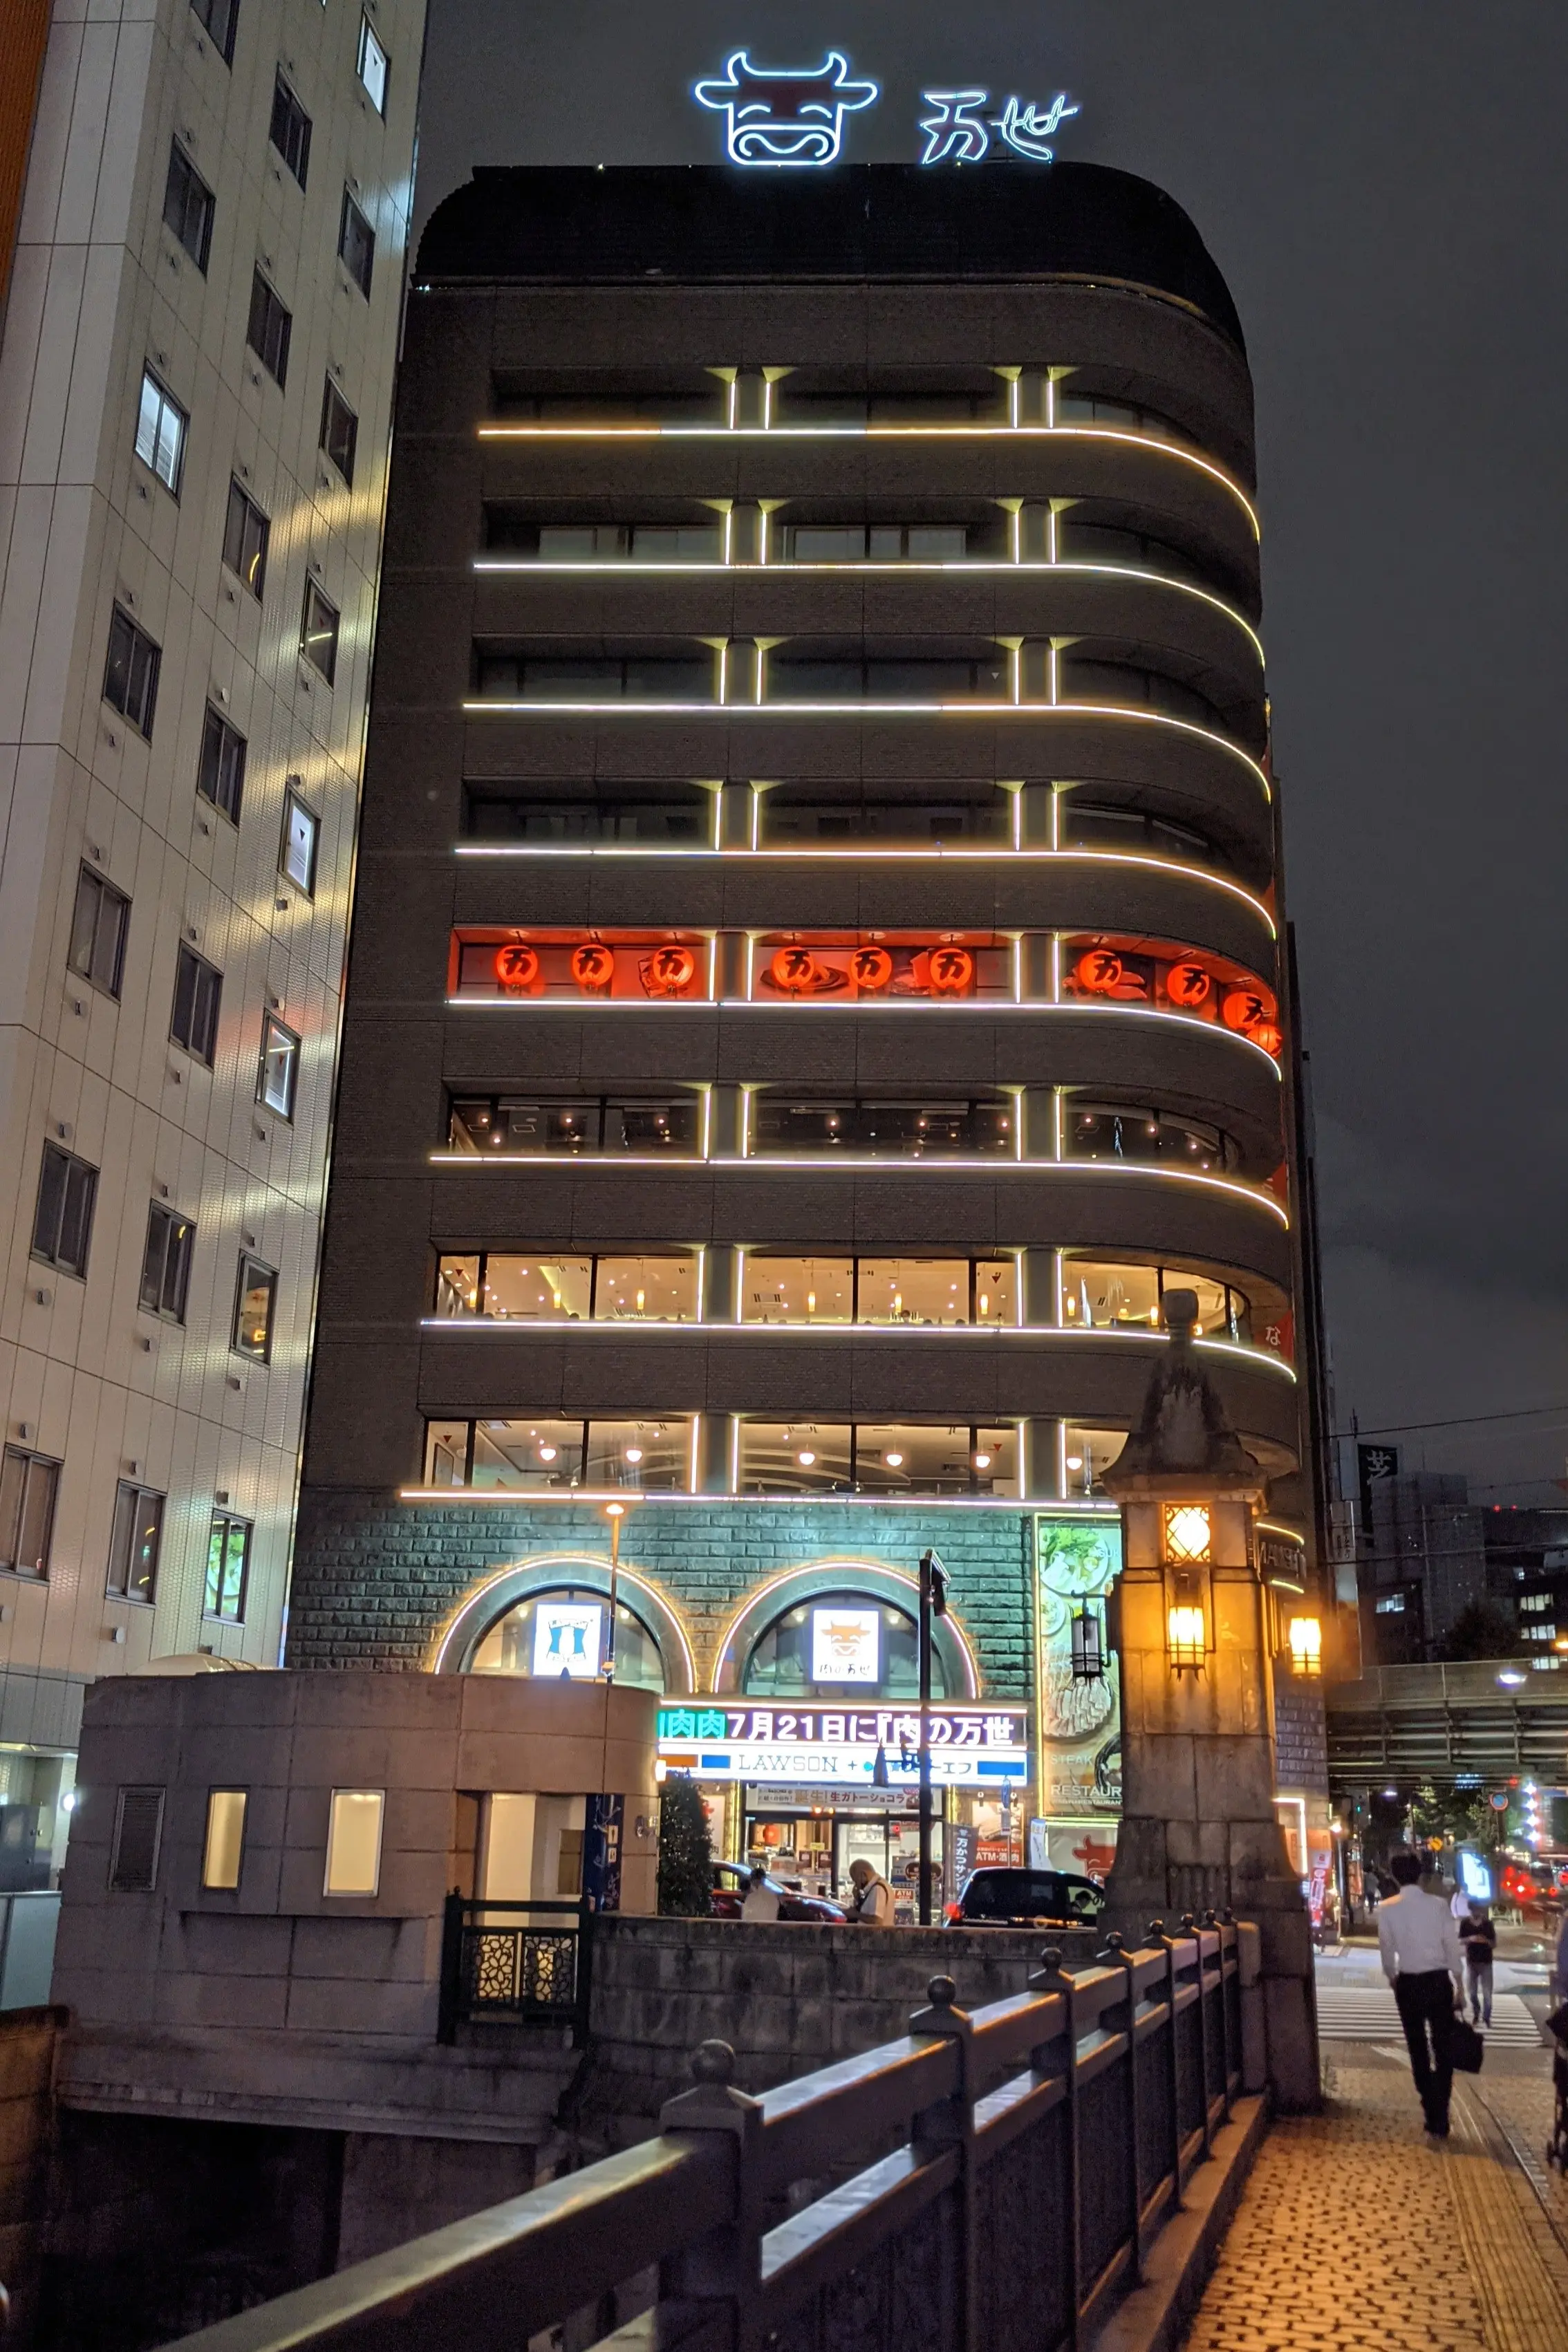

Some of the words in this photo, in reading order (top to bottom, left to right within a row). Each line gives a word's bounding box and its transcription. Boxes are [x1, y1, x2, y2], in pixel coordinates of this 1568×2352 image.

[919, 90, 1079, 165] 万世
[503, 947, 532, 976] 万
[577, 947, 606, 976] 万
[659, 948, 687, 976] 万
[785, 949, 813, 978] 万
[855, 950, 883, 978] 万
[937, 951, 967, 980] 万
[1093, 953, 1119, 982] 万
[1182, 967, 1207, 996] 万
[819, 1663, 871, 1677] 肉の万世
[738, 1755, 838, 1773] LAWSON
[1051, 1755, 1093, 1766] STEAK
